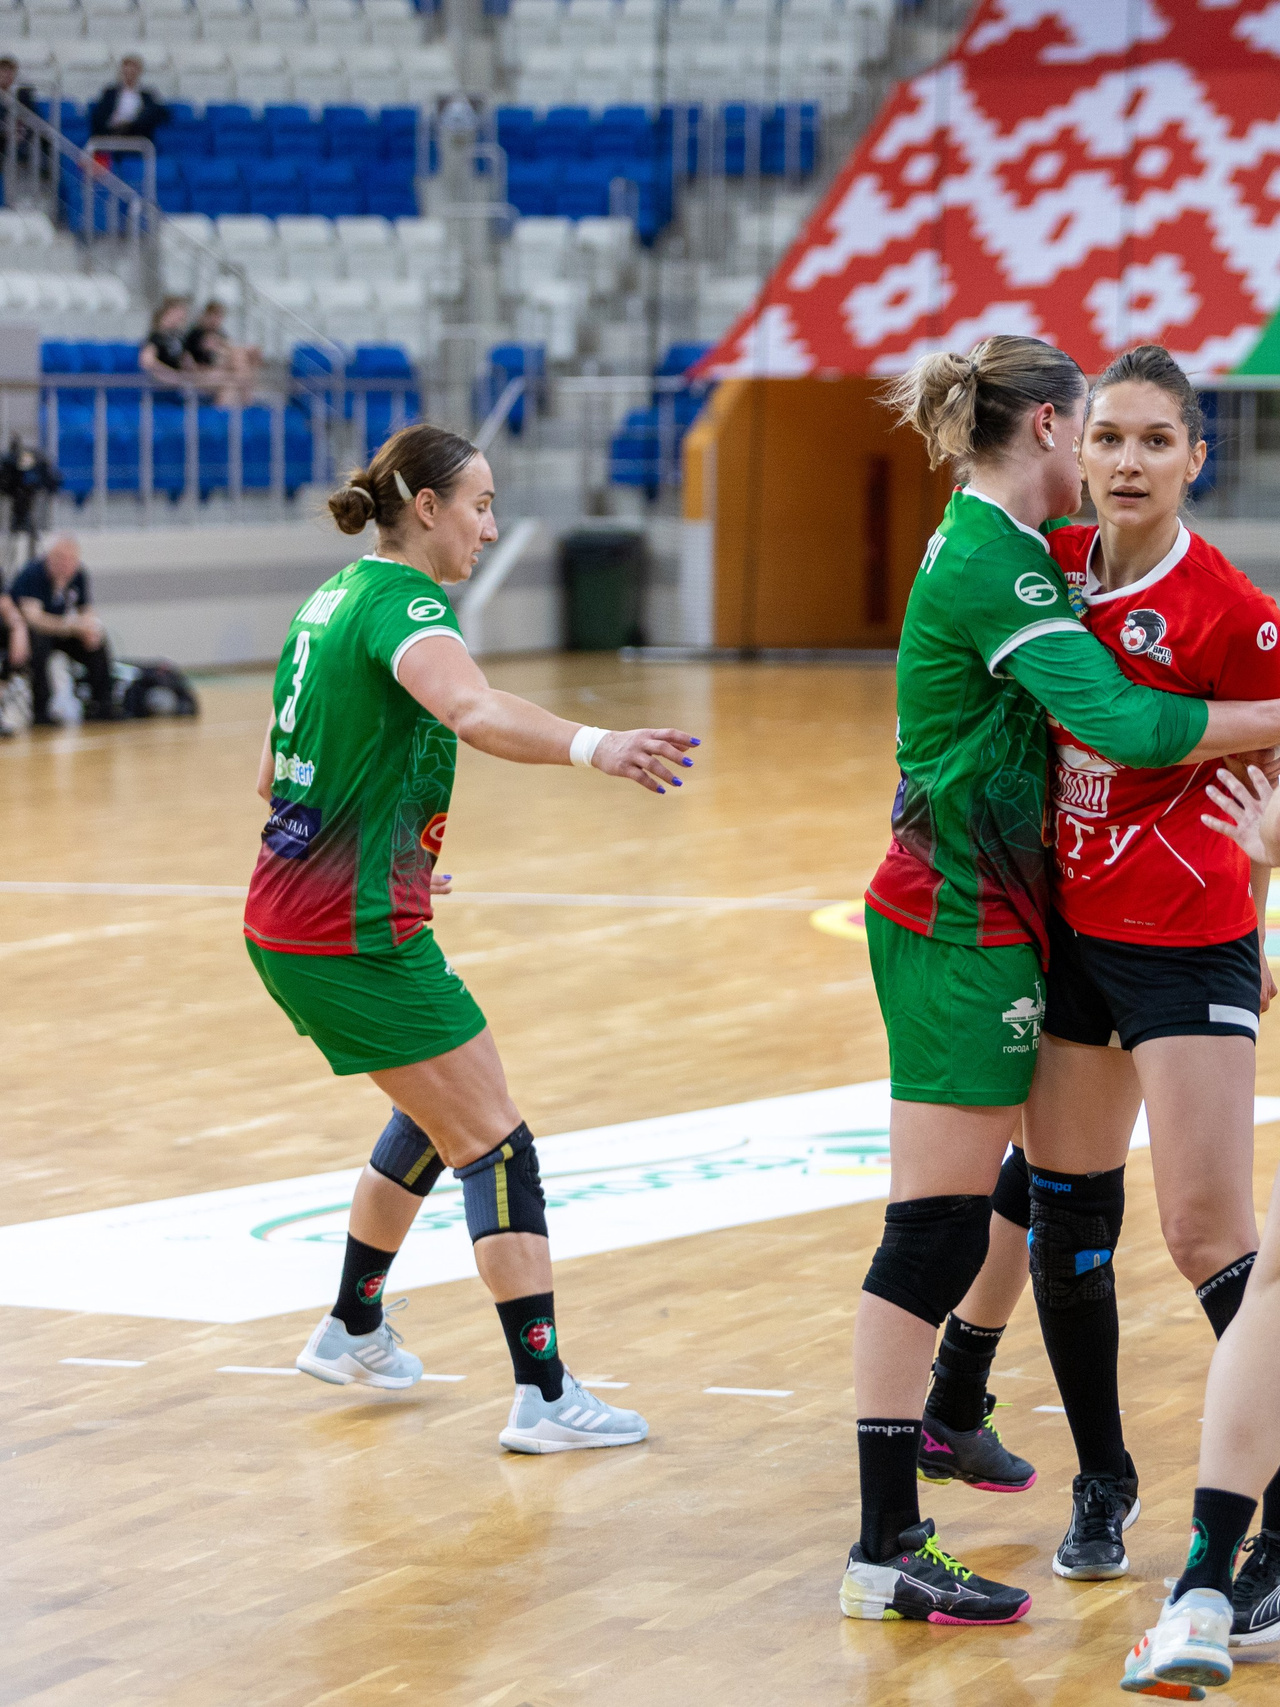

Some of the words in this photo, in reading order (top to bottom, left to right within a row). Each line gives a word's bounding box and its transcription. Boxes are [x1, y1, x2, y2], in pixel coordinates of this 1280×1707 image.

[1152, 645, 1172, 657] BNTU
[279, 631, 310, 733] 3
[1003, 1044, 1029, 1054] ГОРОДА
[1031, 1172, 1073, 1193] Kempa
[960, 1323, 1004, 1338] Kem
[857, 1423, 915, 1437] empa
